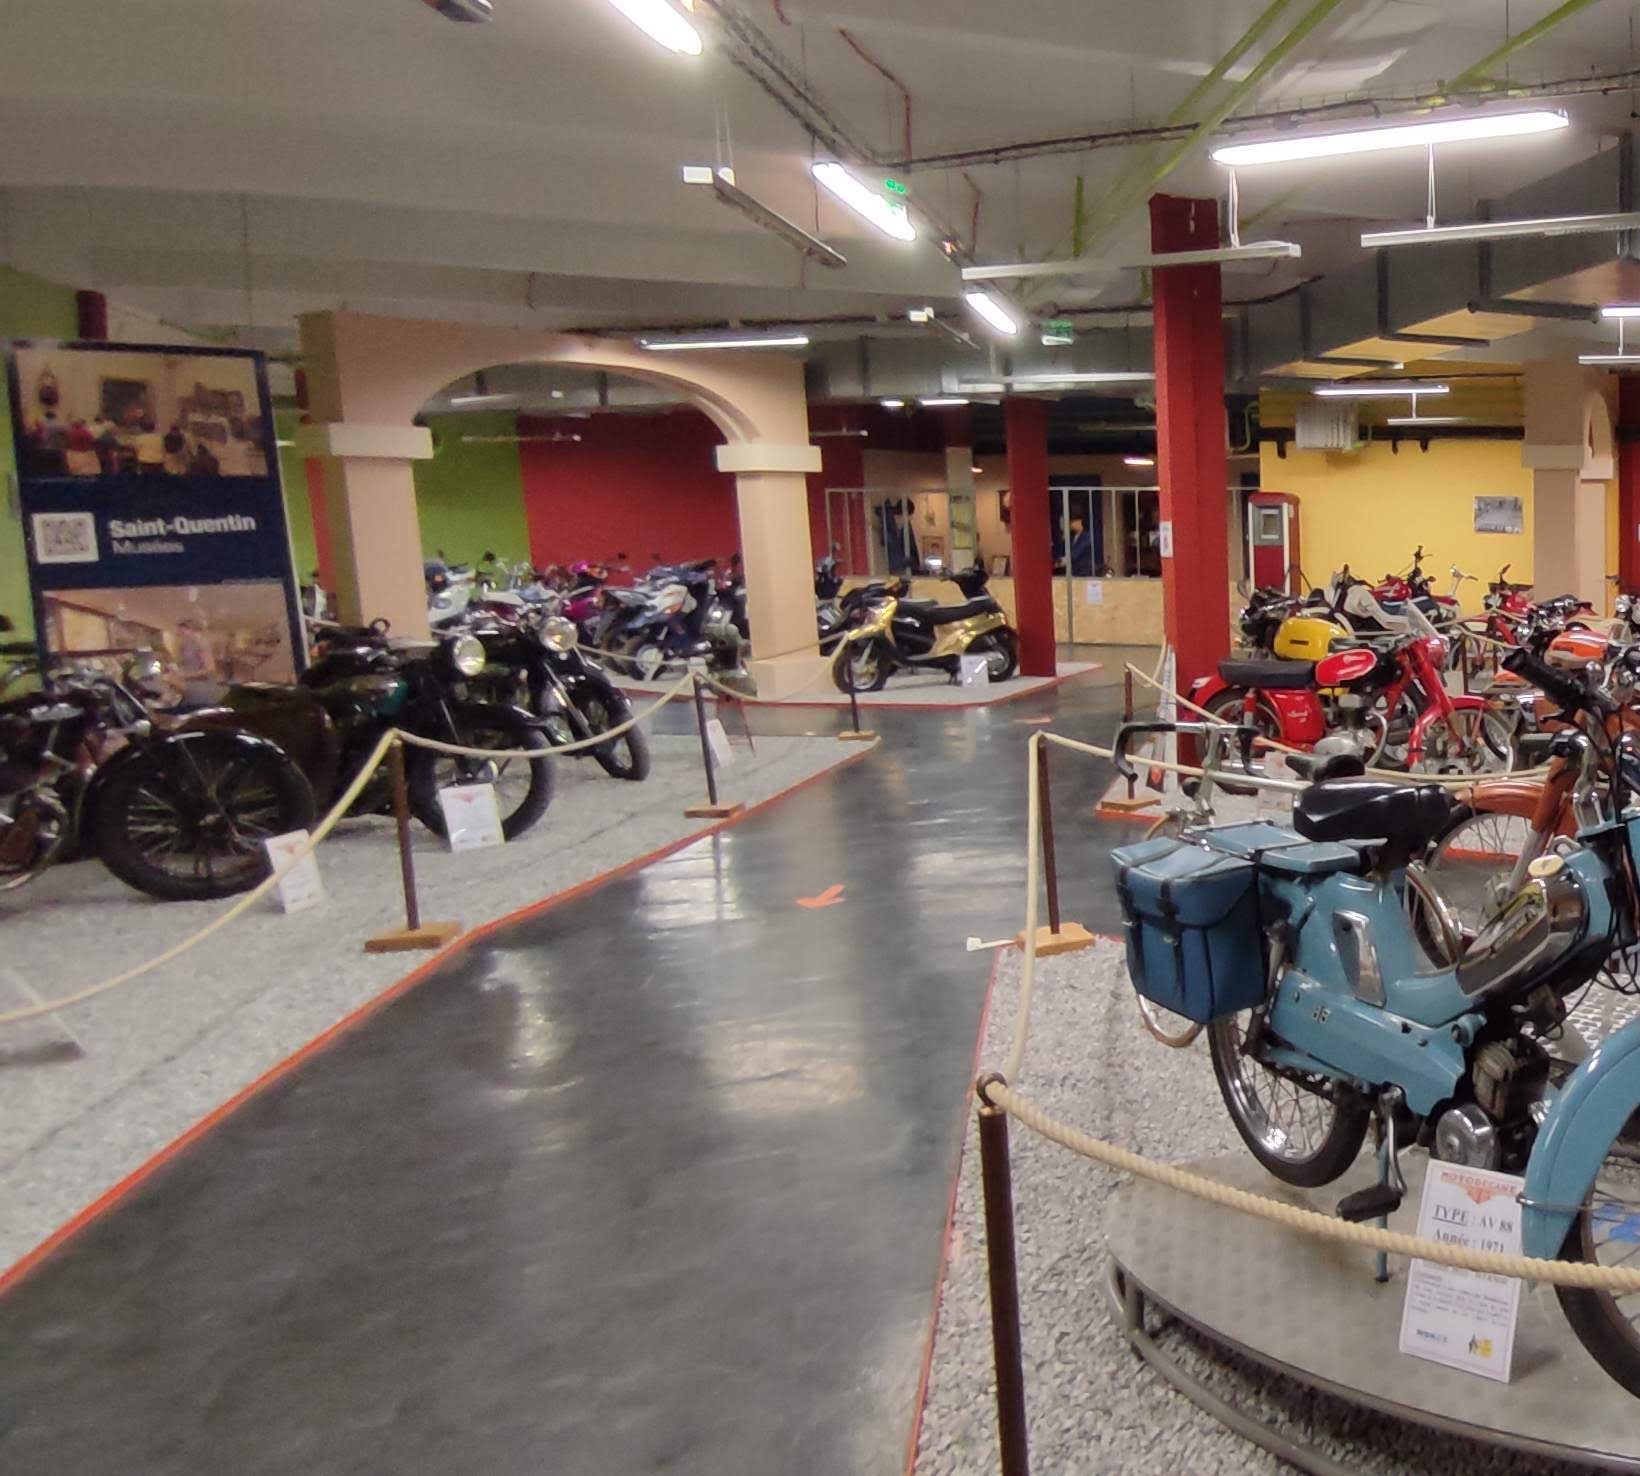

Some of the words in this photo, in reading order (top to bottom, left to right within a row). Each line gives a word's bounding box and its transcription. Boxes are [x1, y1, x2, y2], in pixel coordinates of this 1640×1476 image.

[109, 514, 257, 538] Saint-Quentin
[1440, 1171, 1518, 1194] MOTOBECANE
[1433, 1204, 1469, 1224] TYPE
[1479, 1216, 1497, 1229] AV
[1480, 1239, 1504, 1254] 1971
